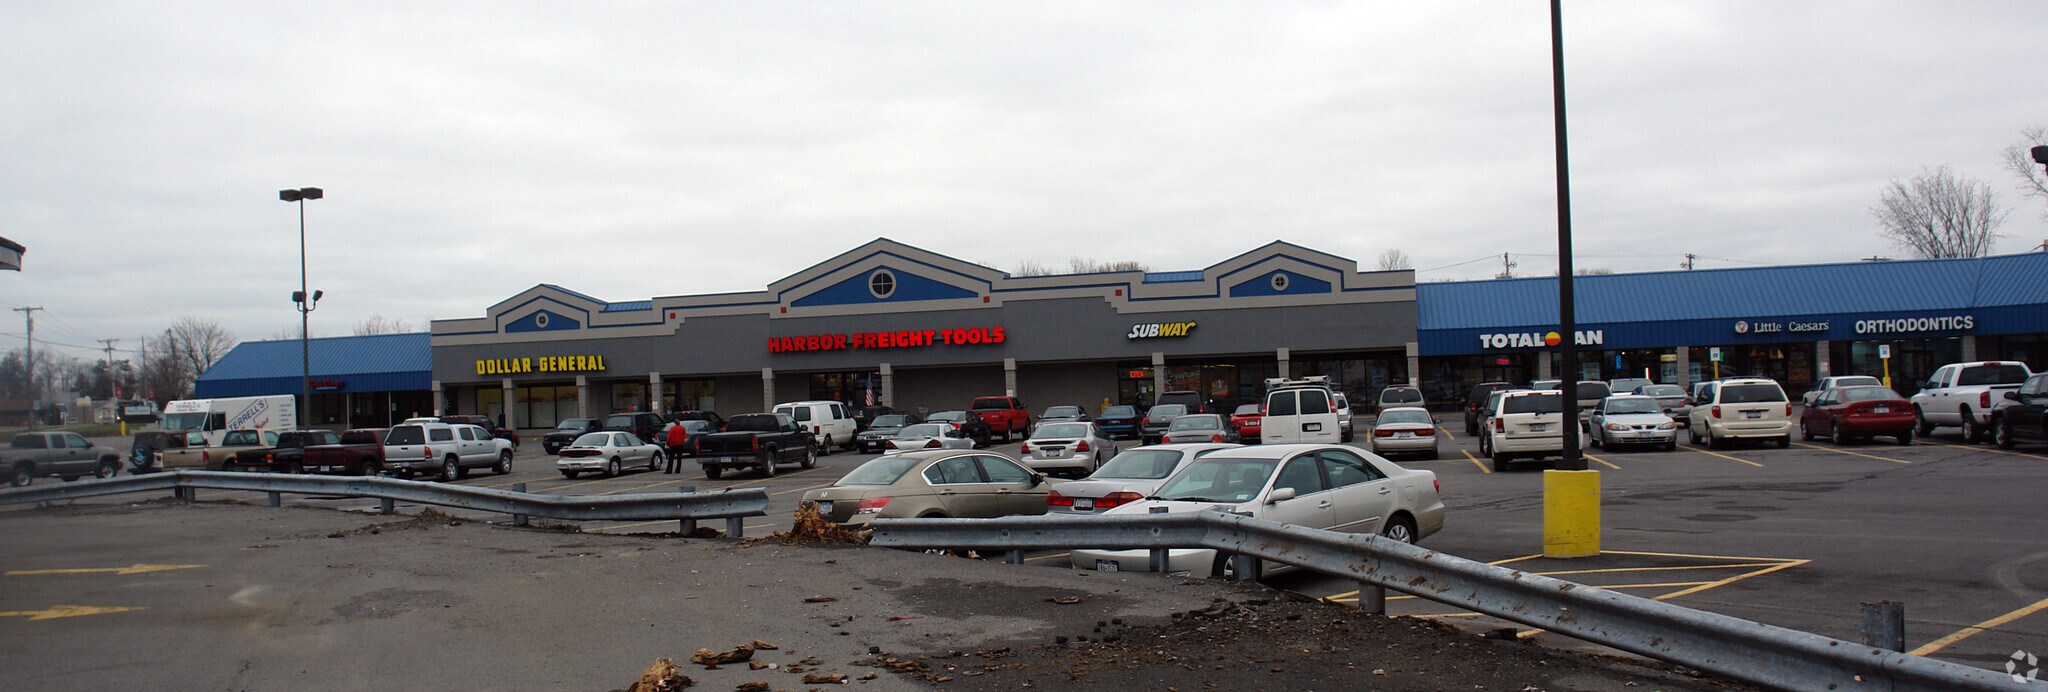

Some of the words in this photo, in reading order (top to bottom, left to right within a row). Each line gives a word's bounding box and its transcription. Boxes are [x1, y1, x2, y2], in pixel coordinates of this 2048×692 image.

[1127, 321, 1197, 339] SUBWAY
[1754, 322, 1782, 333] Little
[1788, 320, 1830, 332] Caesars
[1855, 315, 1973, 334] ORTHODONTICS
[767, 333, 847, 353] HARBOR
[853, 330, 936, 350] FREIGHT
[940, 325, 1005, 346] TOOLS
[1480, 332, 1546, 349] TOTAL
[1574, 330, 1603, 345] AN
[476, 356, 532, 376] DOLLAR
[539, 354, 606, 373] GENERAL
[228, 399, 265, 431] TERRELL'S
